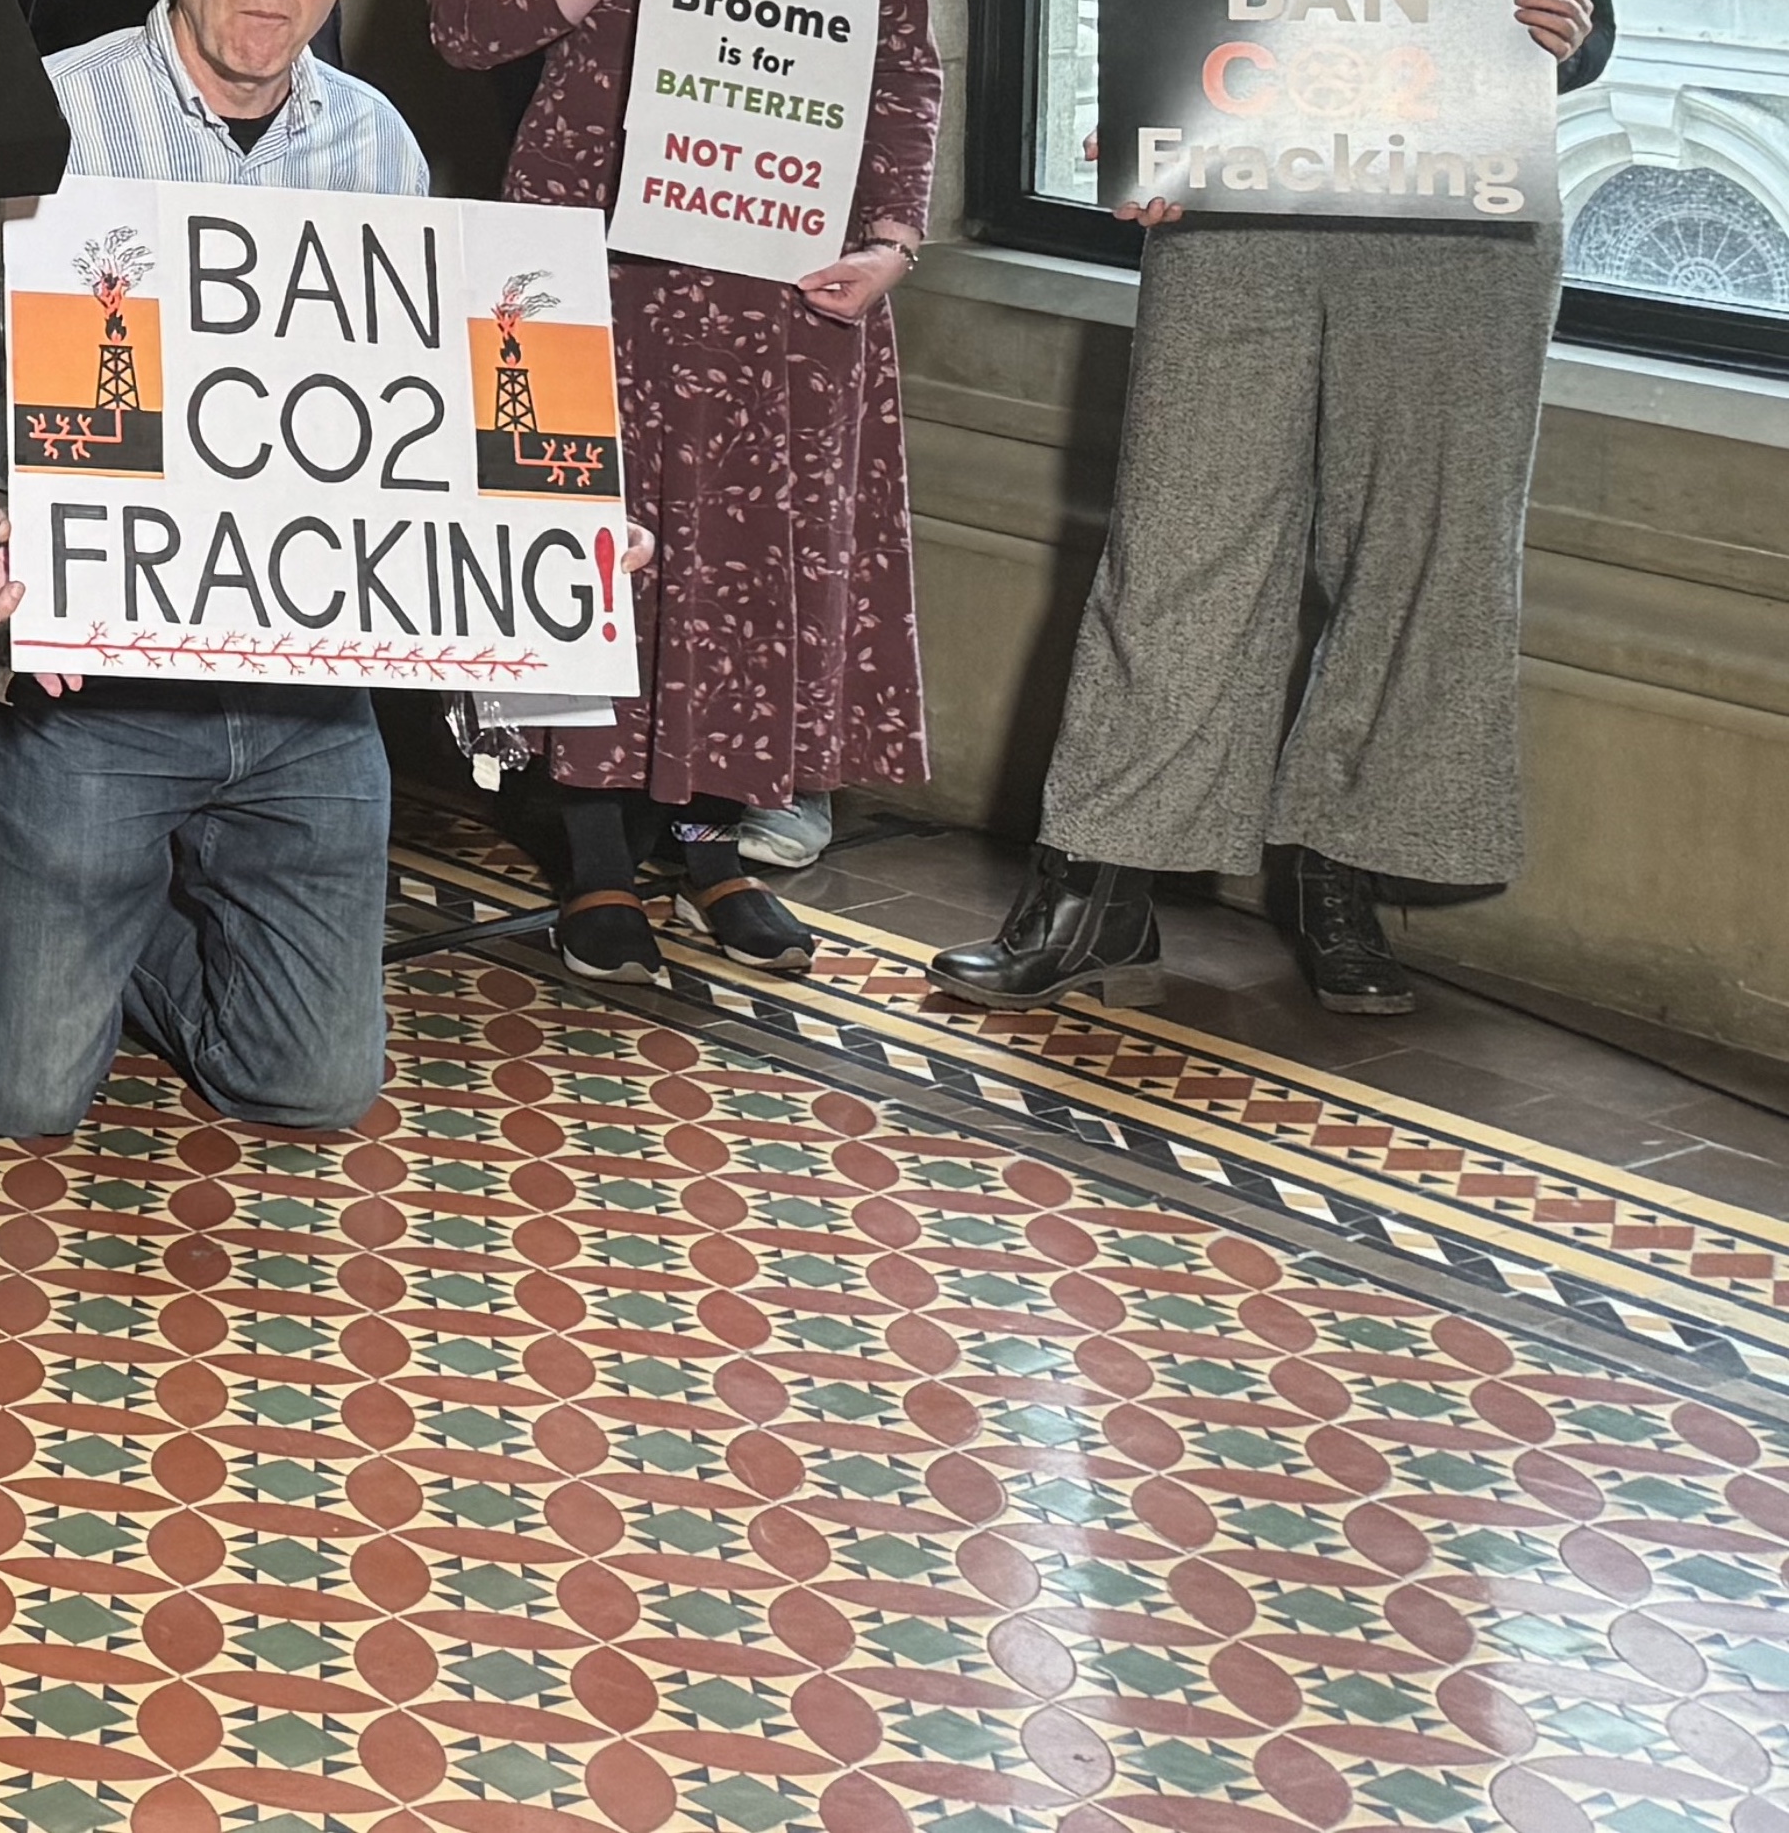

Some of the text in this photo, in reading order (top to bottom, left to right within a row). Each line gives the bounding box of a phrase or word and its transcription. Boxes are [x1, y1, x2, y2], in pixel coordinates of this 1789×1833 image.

[718, 37, 795, 76] is for
[655, 69, 845, 130] BATTERIES
[664, 133, 823, 189] NOT CO2
[1137, 126, 1524, 214] Fracking
[642, 176, 825, 237] FRACKING
[187, 215, 440, 349] BAN
[186, 367, 450, 492] CO2
[51, 502, 618, 643] FRACKING!
